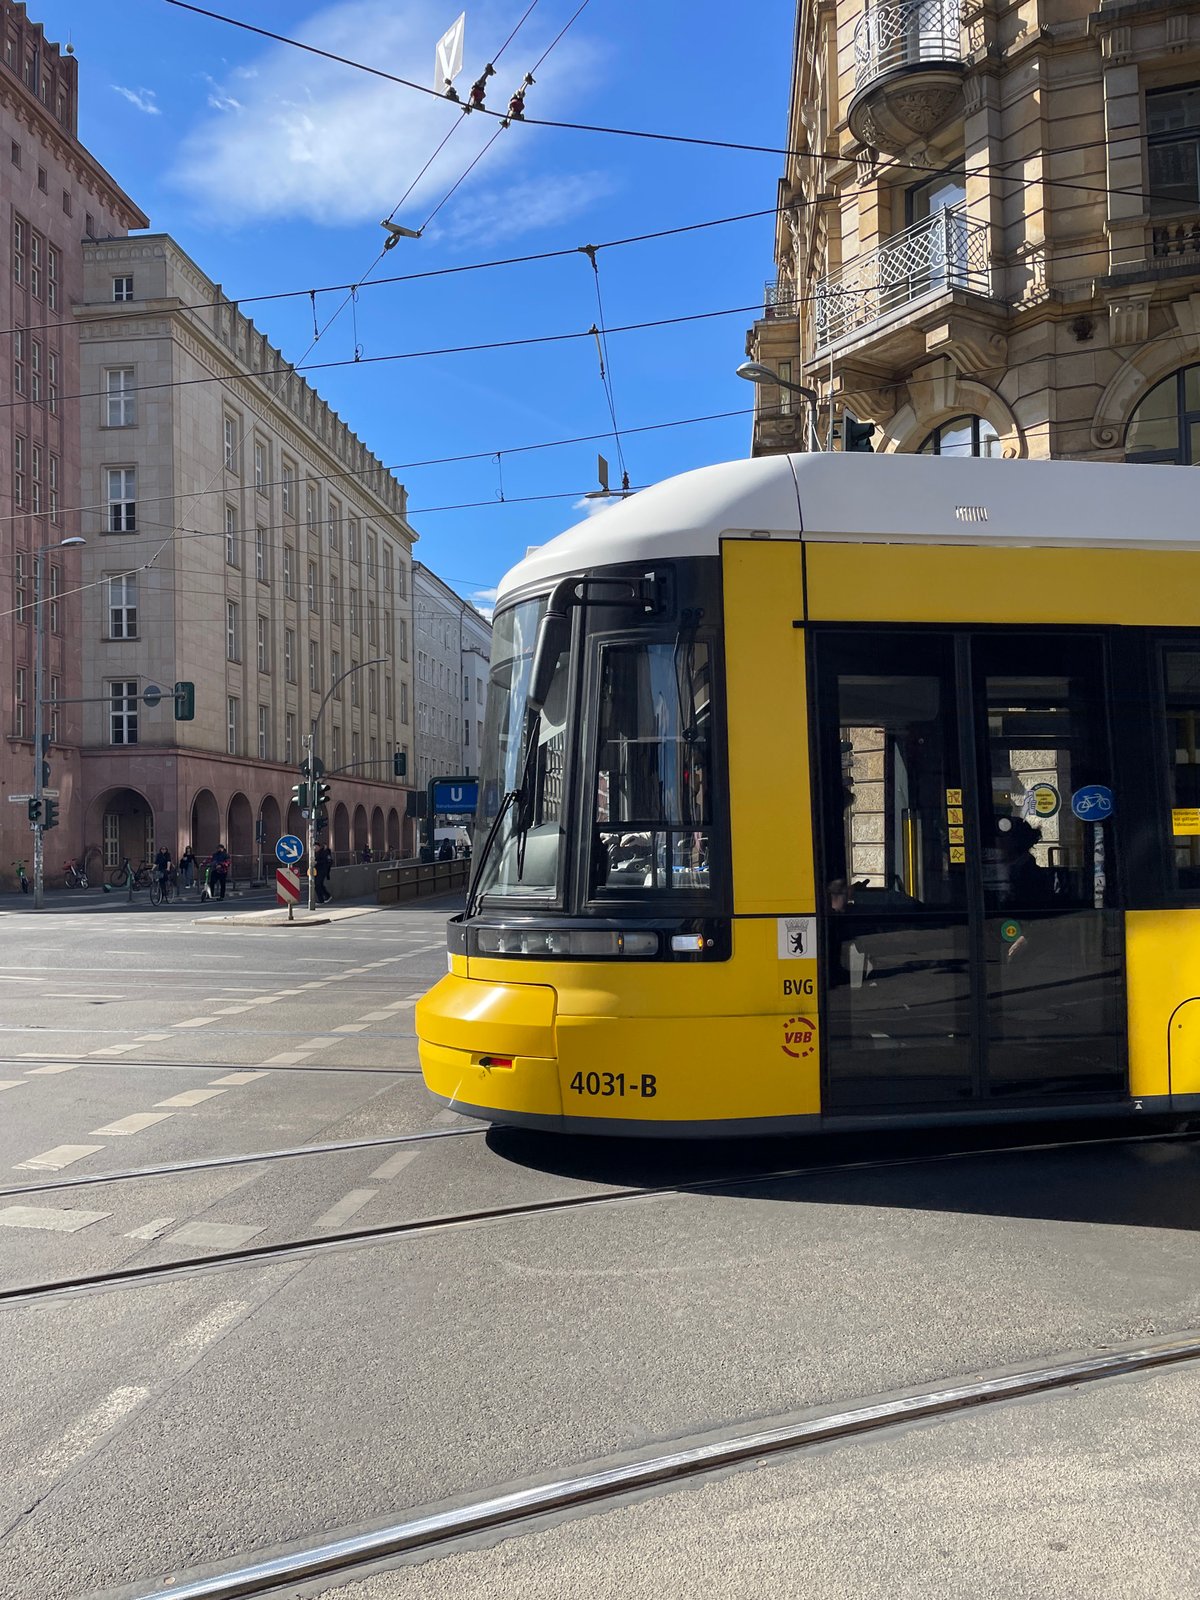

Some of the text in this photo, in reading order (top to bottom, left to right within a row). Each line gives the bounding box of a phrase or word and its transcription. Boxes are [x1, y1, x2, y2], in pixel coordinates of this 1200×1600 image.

[451, 787, 463, 802] U
[783, 979, 814, 996] BVG
[784, 1031, 813, 1044] VBB
[570, 1071, 657, 1098] 4031-B
